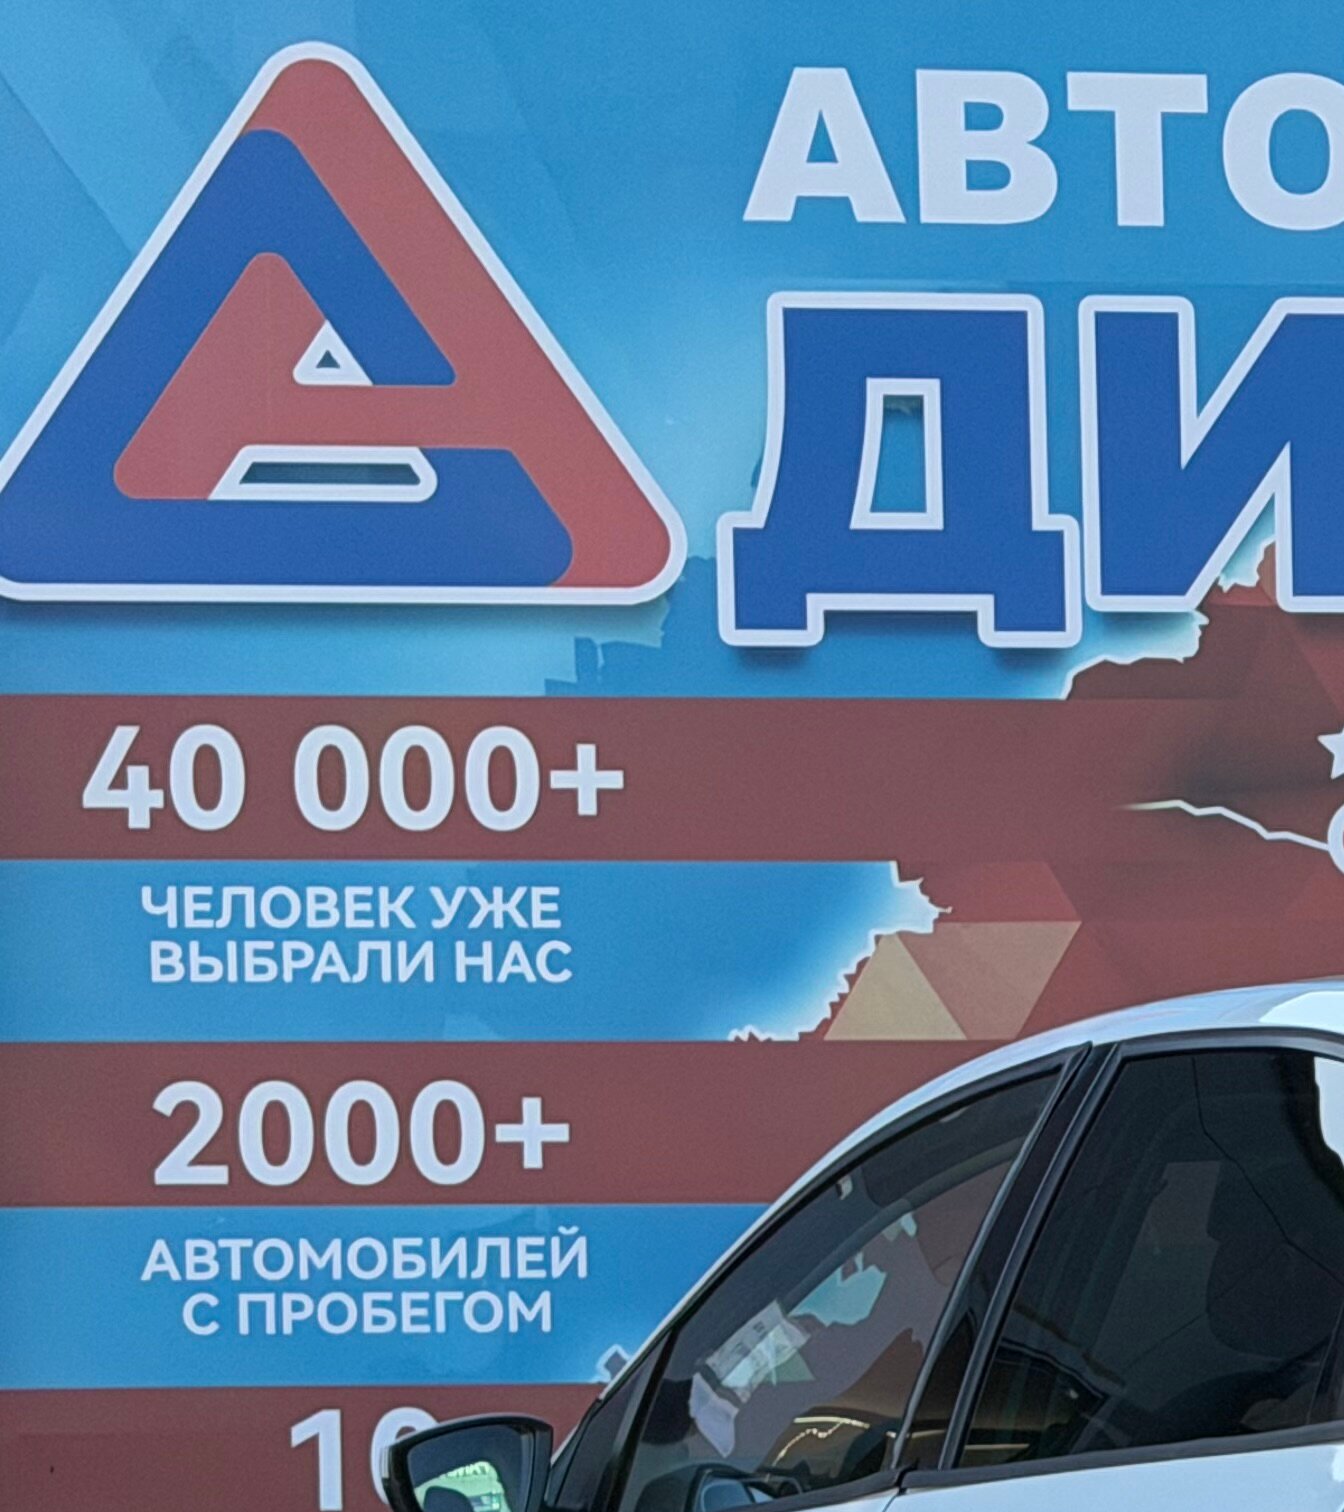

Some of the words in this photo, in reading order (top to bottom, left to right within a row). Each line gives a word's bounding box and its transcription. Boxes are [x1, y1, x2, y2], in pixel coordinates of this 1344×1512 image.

[82, 724, 246, 831] 40
[293, 724, 624, 832] 000+
[141, 885, 416, 929] ЧЕЛОВЕК
[429, 885, 562, 930] УЖЕ
[150, 940, 435, 984] ВЫБРАЛИ
[455, 939, 573, 983] НАС
[152, 1079, 570, 1186] 2000+
[140, 1226, 589, 1281] АВТОМОБИЛЕЙ
[182, 1292, 220, 1336] С
[238, 1290, 552, 1336] ПРОБЕГОМ
